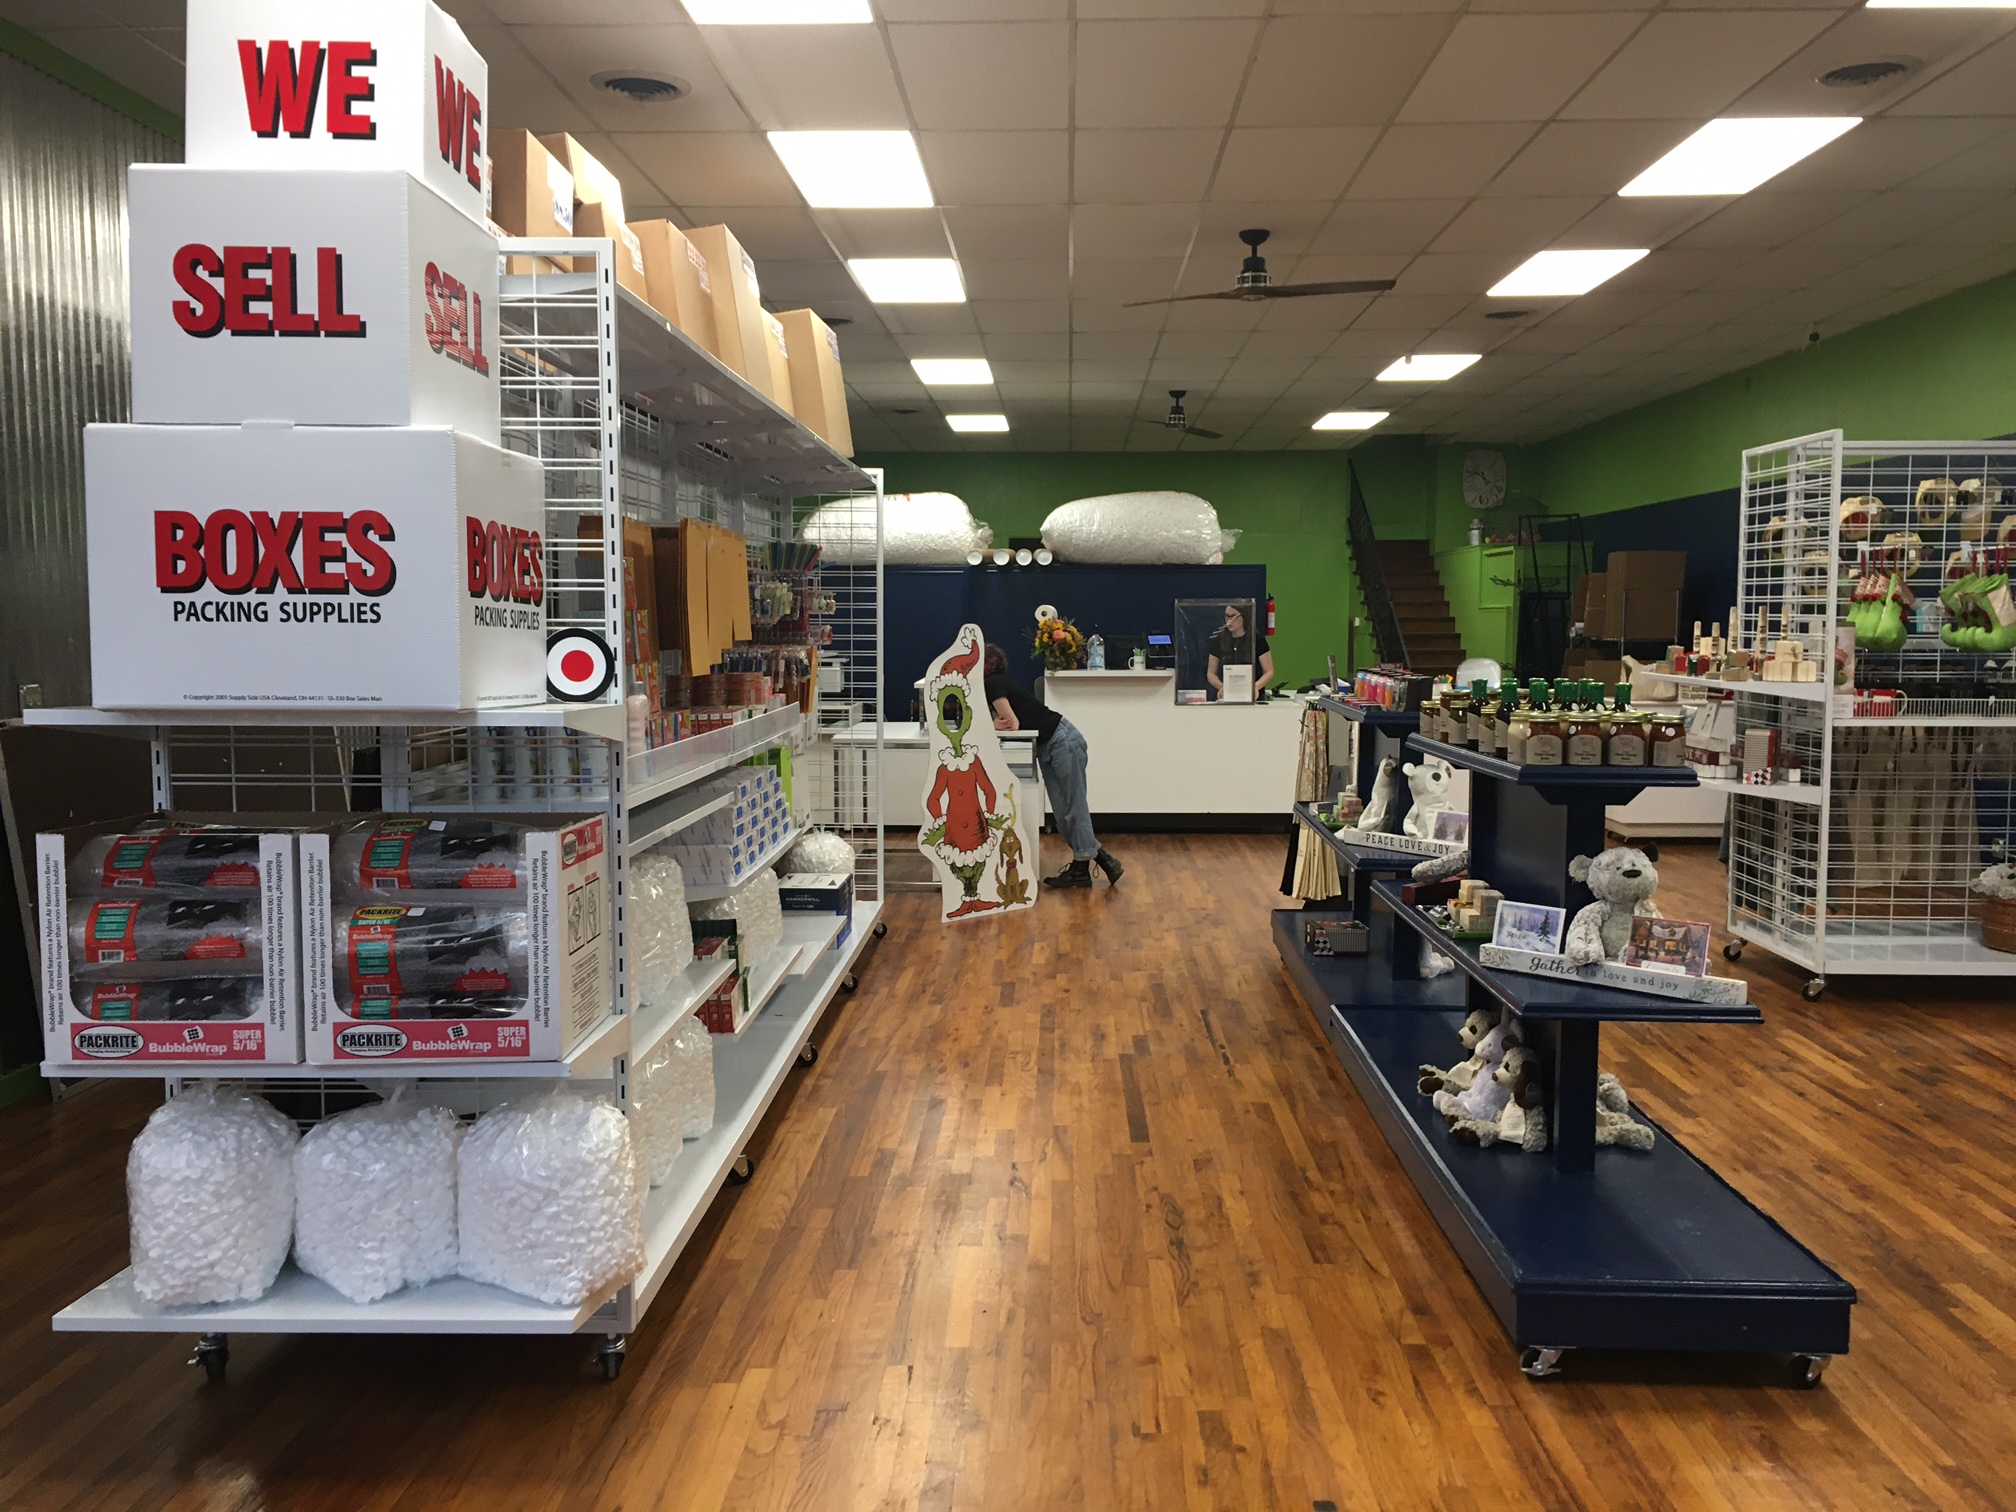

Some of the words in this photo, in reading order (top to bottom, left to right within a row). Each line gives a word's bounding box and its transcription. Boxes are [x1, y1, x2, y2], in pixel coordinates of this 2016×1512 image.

[237, 38, 377, 140] WE
[433, 54, 481, 192] WE
[171, 243, 367, 339] SELL
[423, 261, 490, 378] SELL
[153, 509, 397, 598] BOXES
[466, 515, 543, 607] BOXES
[173, 600, 269, 624] PACKING
[279, 601, 382, 625] SUPPLIES
[474, 605, 508, 628] PACKING
[509, 609, 540, 631] SUPPLIES
[1365, 833, 1395, 847] PEACE
[1399, 839, 1423, 851] LOVE
[1432, 844, 1450, 855] JOY
[266, 860, 274, 883] Retains
[44, 876, 52, 907] Retention
[276, 896, 284, 915] brand
[359, 908, 403, 916] PACKRITE
[46, 918, 54, 937] Nylon
[266, 926, 275, 946] longer
[309, 918, 317, 936] Nylon
[532, 923, 540, 944] longer
[46, 944, 54, 969] features
[55, 939, 63, 960] longer
[276, 948, 284, 967] Nylon
[309, 943, 317, 968] features
[319, 938, 327, 959] longer
[541, 945, 549, 964] Nylon
[1603, 969, 1627, 982] love
[1633, 975, 1655, 986] and
[1659, 979, 1679, 991] joy
[278, 978, 286, 1009] Retention
[79, 1035, 139, 1048] PACKRITE
[232, 1029, 261, 1039] SUPER
[341, 1033, 402, 1047] PACKRITE
[497, 1027, 526, 1036] SUPER
[149, 1042, 228, 1055] BubbleWrap
[412, 1039, 492, 1053] BubbleWrap
